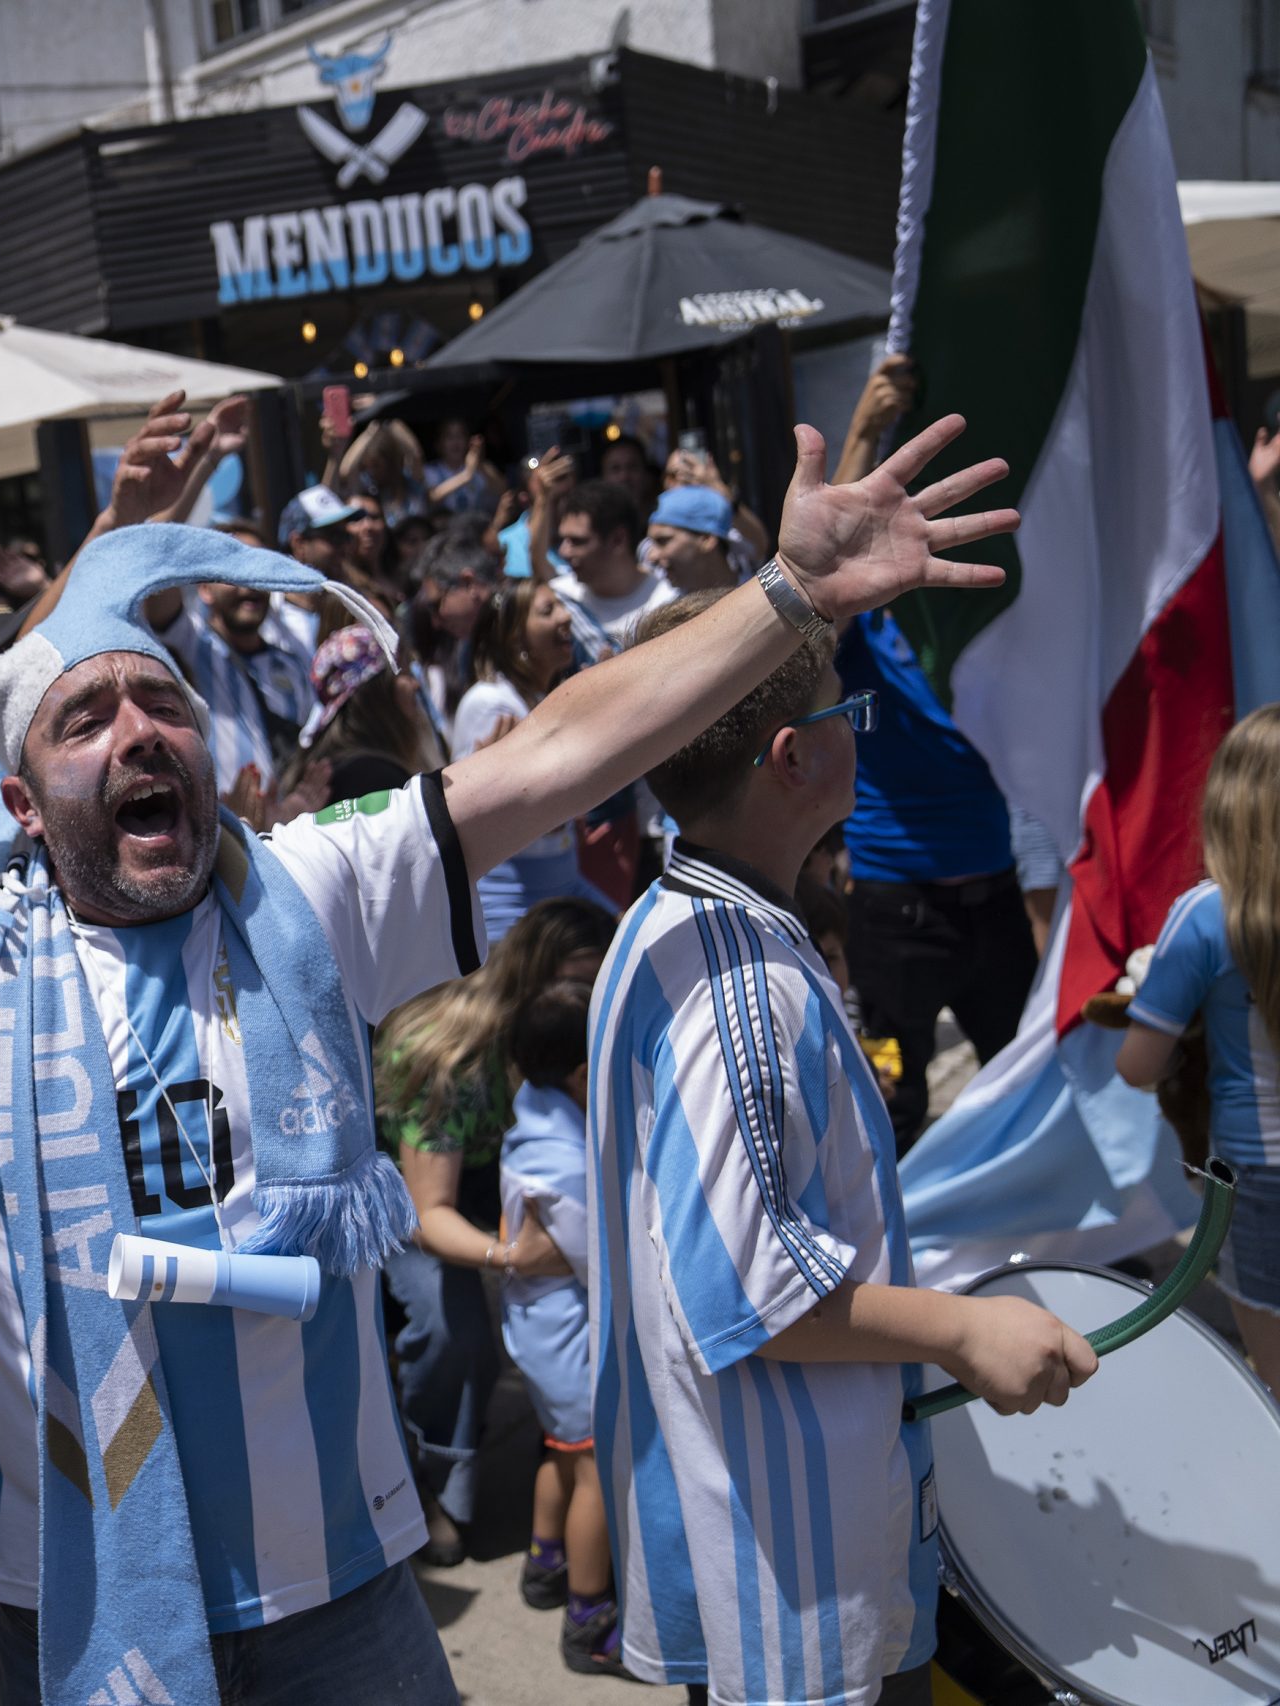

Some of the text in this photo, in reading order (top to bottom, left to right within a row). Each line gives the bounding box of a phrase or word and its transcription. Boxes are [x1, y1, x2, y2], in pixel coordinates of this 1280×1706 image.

[210, 176, 533, 305] MENDUCOS
[679, 290, 824, 325] AUSTRAL
[117, 1078, 236, 1217] 10
